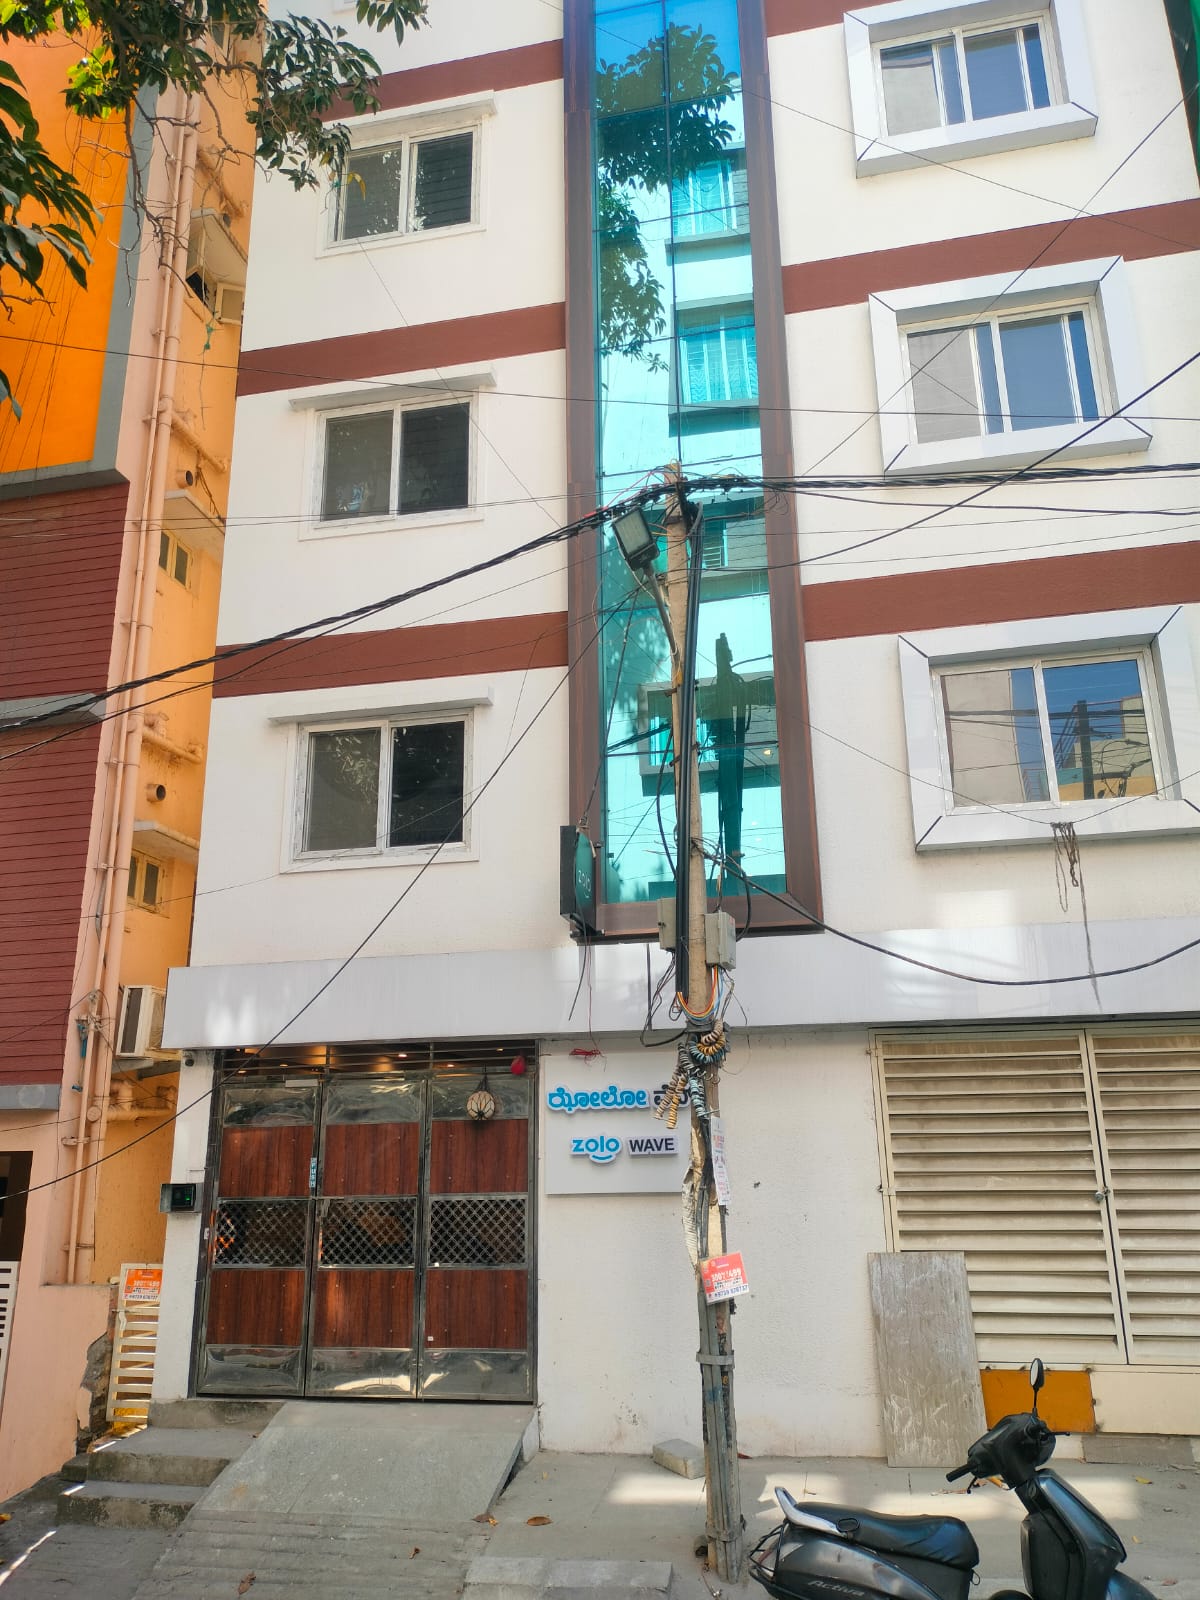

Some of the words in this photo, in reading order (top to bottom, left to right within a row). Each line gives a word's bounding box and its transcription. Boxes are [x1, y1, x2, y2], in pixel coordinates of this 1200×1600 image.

[572, 1136, 620, 1153] zolo
[629, 1137, 675, 1152] WAVE
[808, 1580, 865, 1597] Activa
